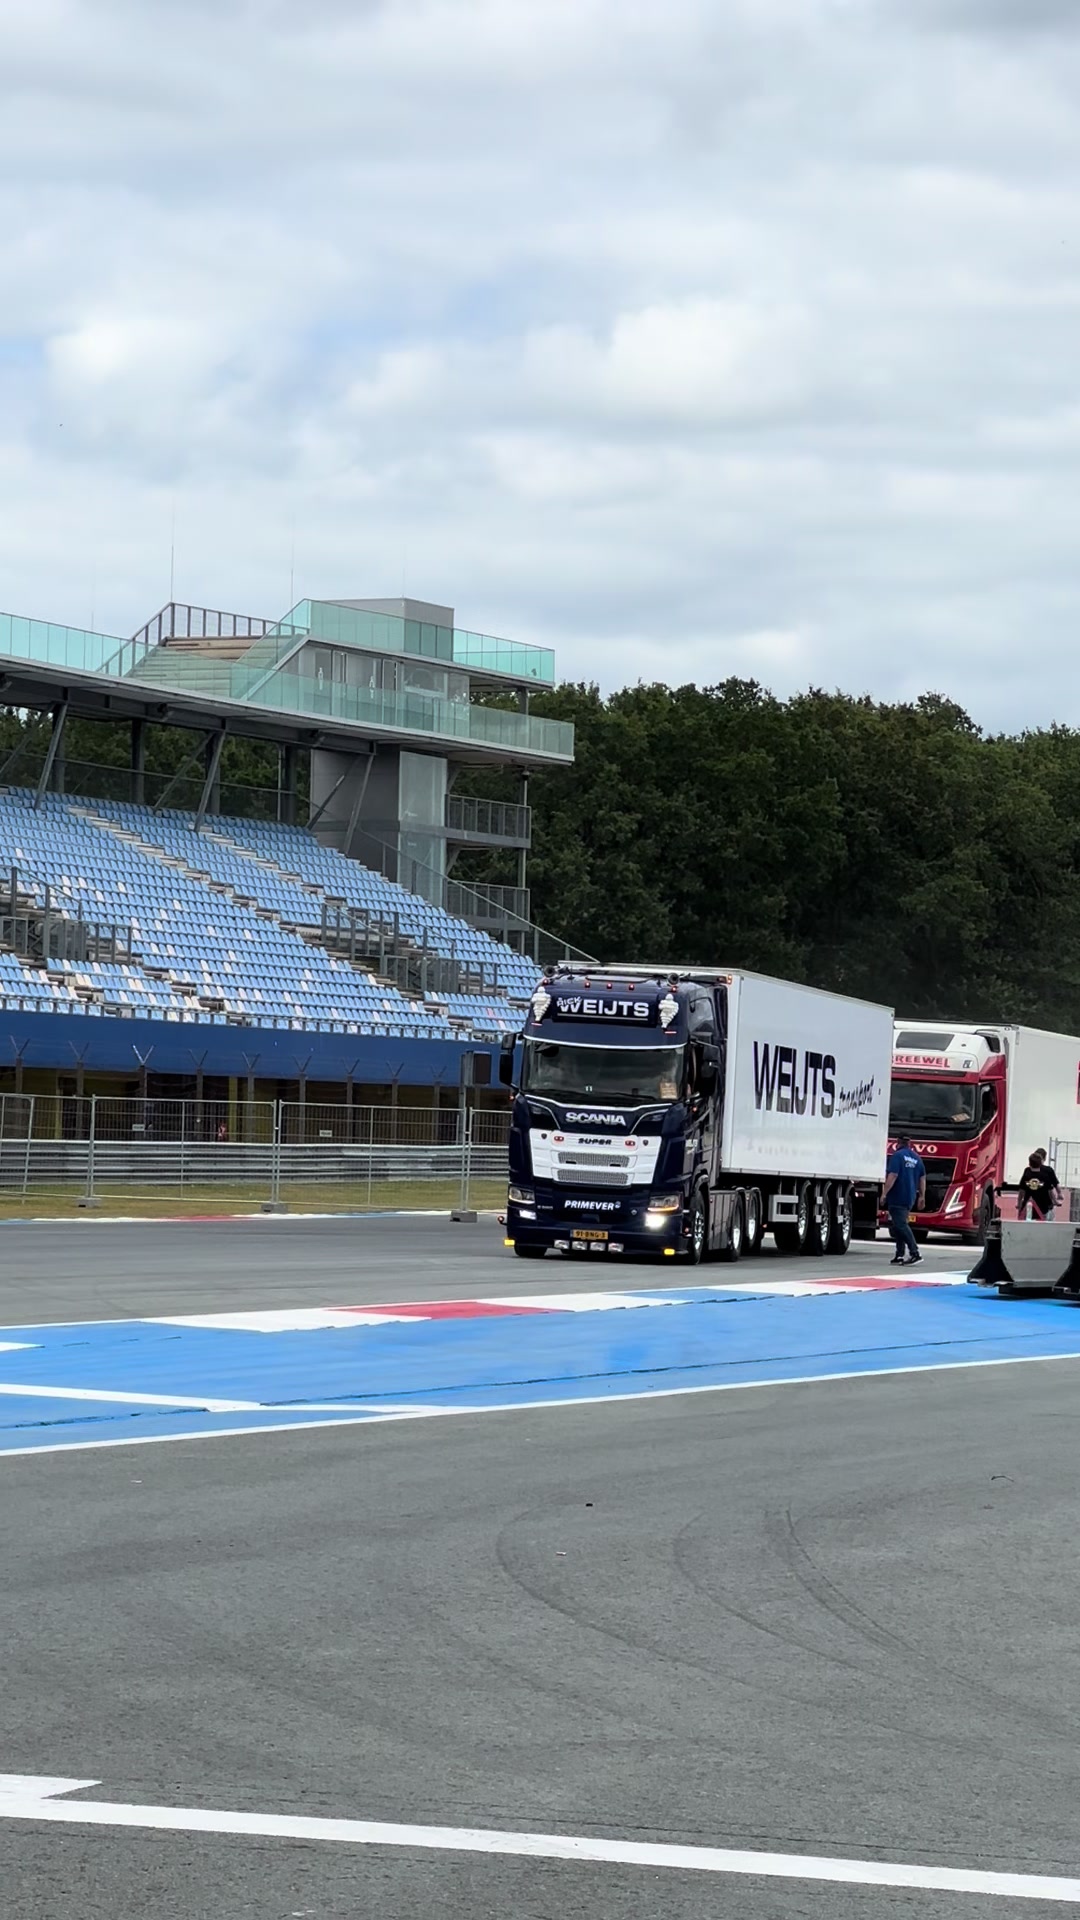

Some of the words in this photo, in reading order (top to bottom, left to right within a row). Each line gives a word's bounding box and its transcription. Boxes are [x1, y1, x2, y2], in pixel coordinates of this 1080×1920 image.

[560, 999, 649, 1017] WEIJTS
[753, 1040, 836, 1119] WEIJTS
[565, 1111, 626, 1126] SCANIA
[578, 1137, 612, 1145] SUPER
[564, 1199, 614, 1211] PRIMEVER
